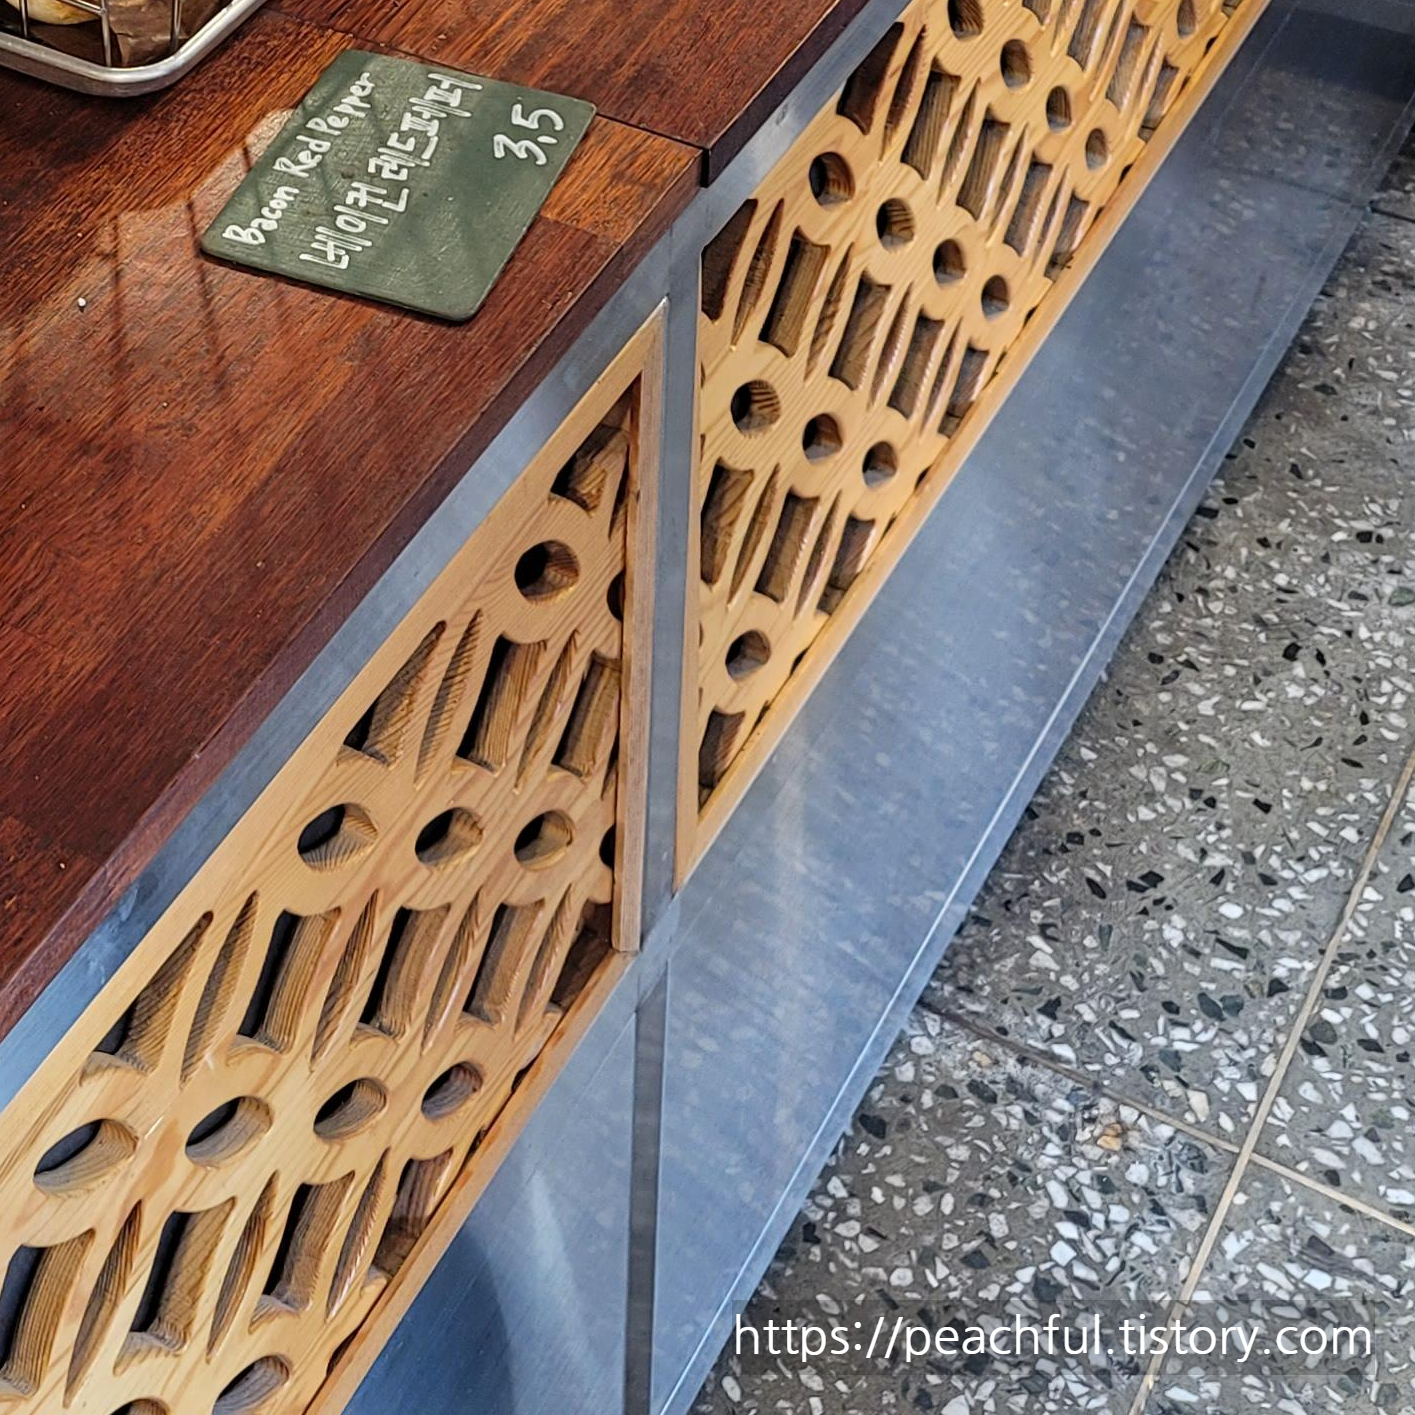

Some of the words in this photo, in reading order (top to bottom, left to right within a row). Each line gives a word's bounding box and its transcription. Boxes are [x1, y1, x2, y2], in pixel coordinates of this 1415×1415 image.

[222, 186, 300, 246] Bacon
[273, 135, 331, 178] Red
[306, 72, 375, 137] Pepper
